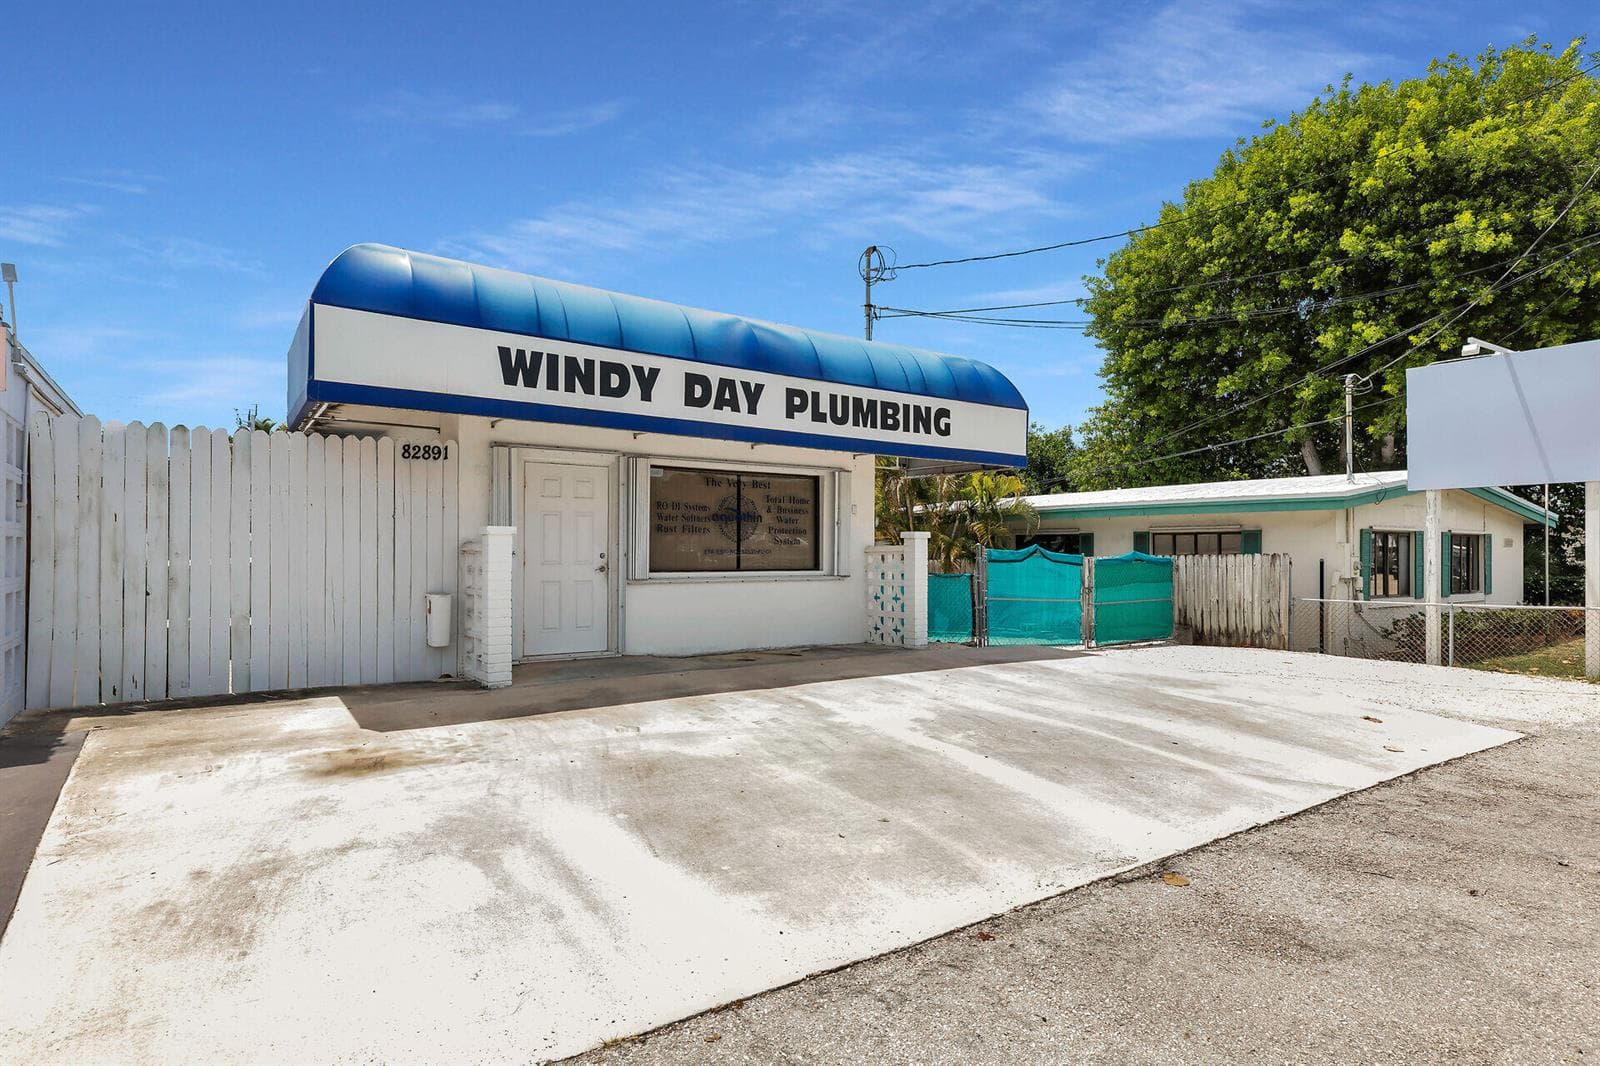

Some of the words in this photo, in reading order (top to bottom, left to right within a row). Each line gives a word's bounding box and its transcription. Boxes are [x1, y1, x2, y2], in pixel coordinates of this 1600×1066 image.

[498, 345, 660, 403] WINDY
[684, 373, 765, 415] DAY
[785, 388, 952, 437] PLUMBING
[401, 444, 449, 461] 82891
[705, 477, 722, 488] The
[752, 480, 771, 490] Best
[765, 495, 785, 504] Total
[657, 513, 678, 521] Water
[776, 515, 799, 525] Water
[657, 524, 677, 533] Rust
[682, 525, 711, 534] Filters
[768, 527, 807, 535] Protection
